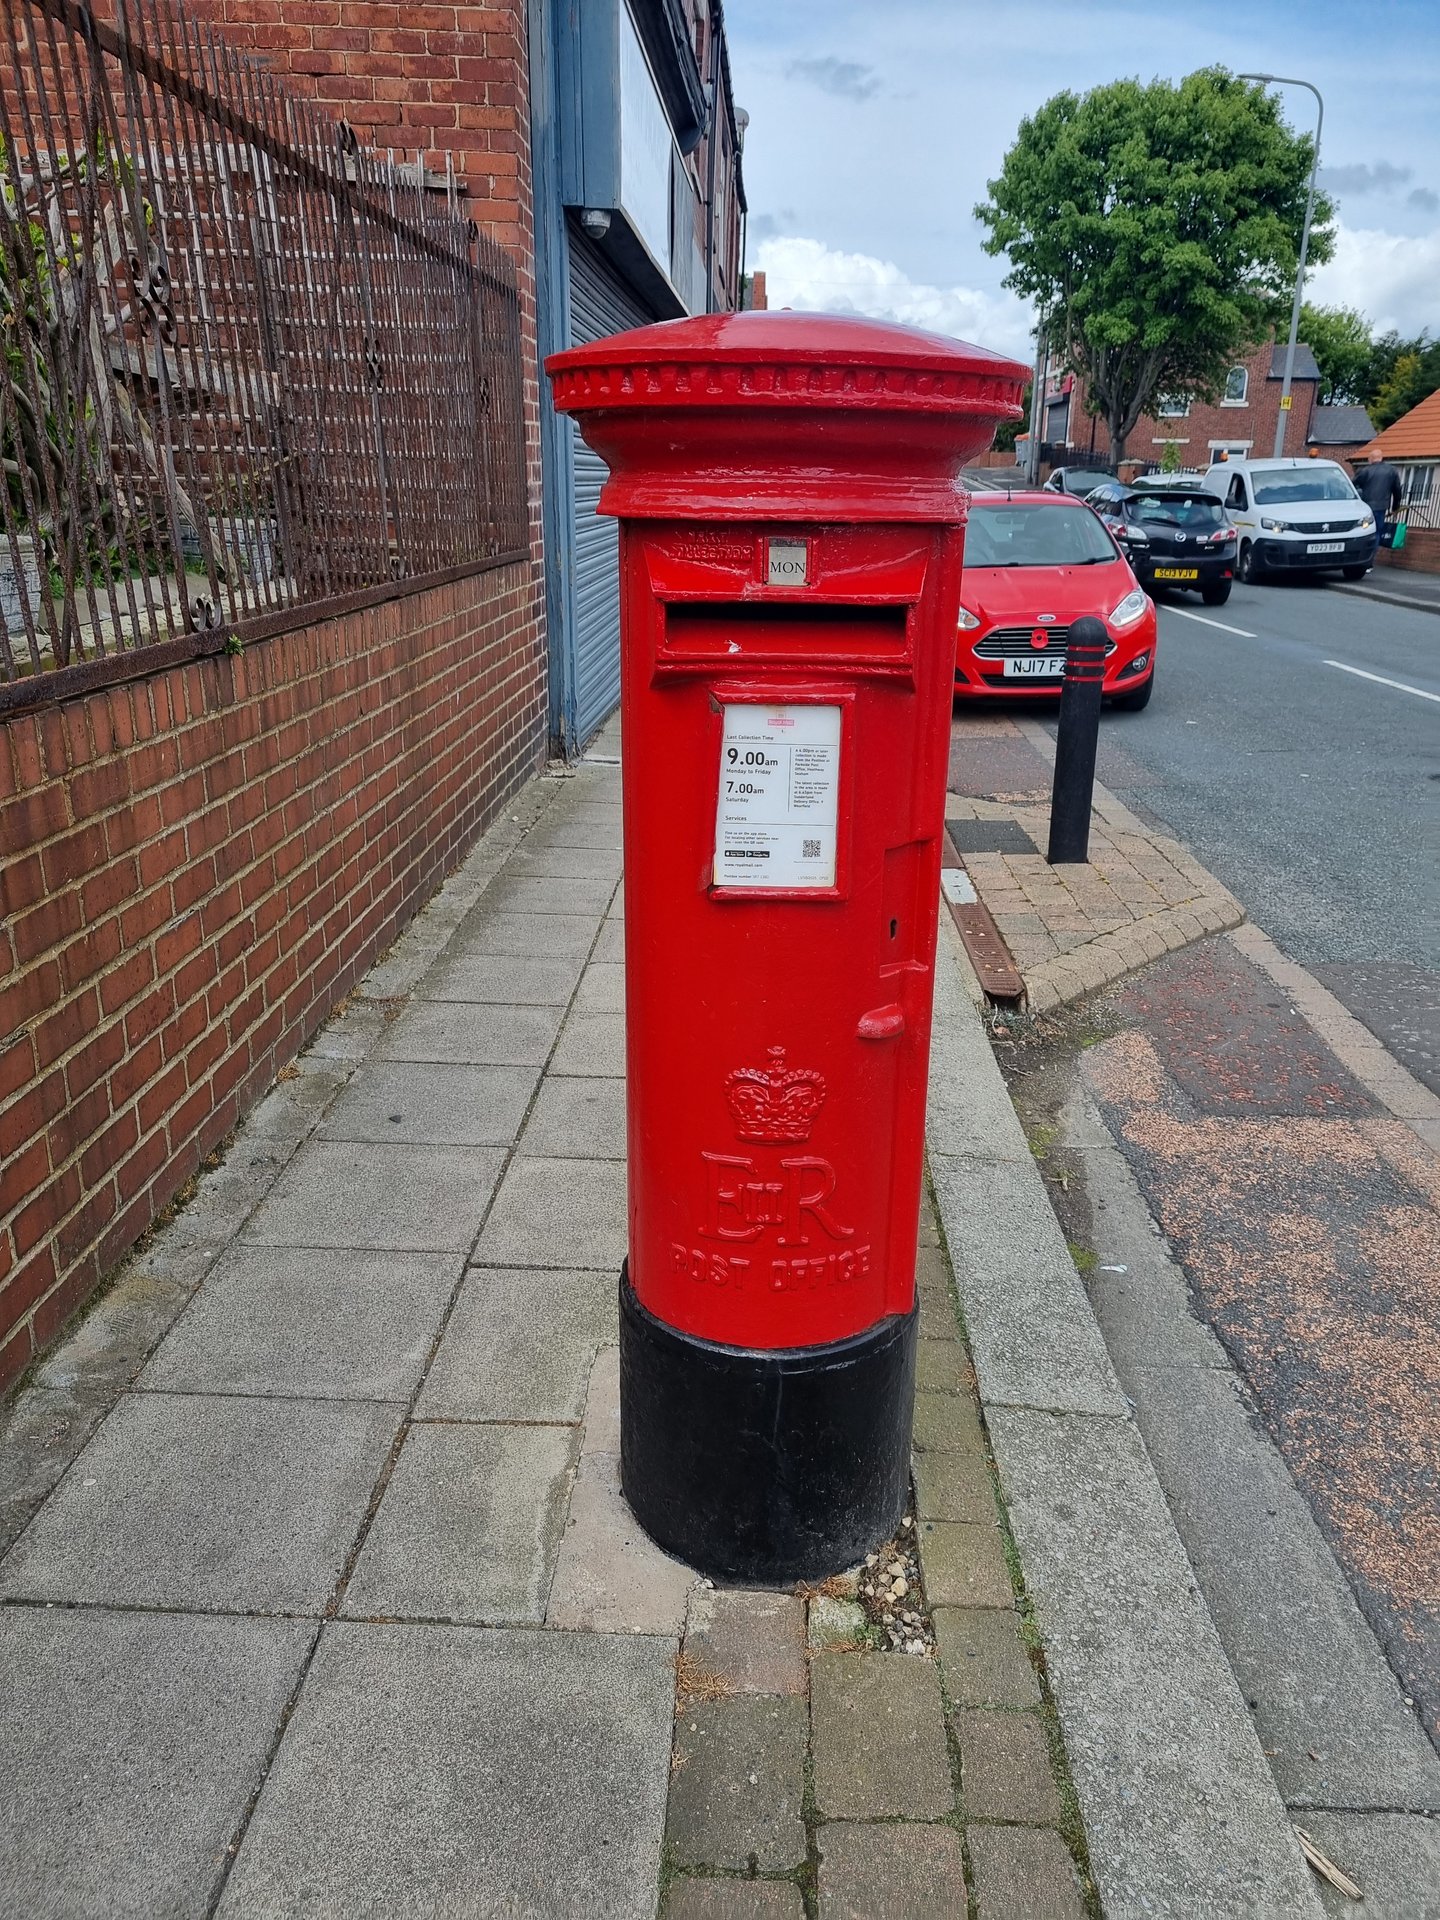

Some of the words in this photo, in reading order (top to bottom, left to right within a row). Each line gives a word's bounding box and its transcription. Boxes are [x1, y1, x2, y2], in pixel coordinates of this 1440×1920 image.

[770, 561, 806, 574] MON
[1013, 660, 1045, 673] NJ17
[1049, 660, 1067, 673] FZ
[727, 747, 779, 766] 9.00am
[726, 781, 764, 794] 7.00am
[671, 1242, 750, 1290] POST
[769, 1244, 871, 1292] OFFICE
